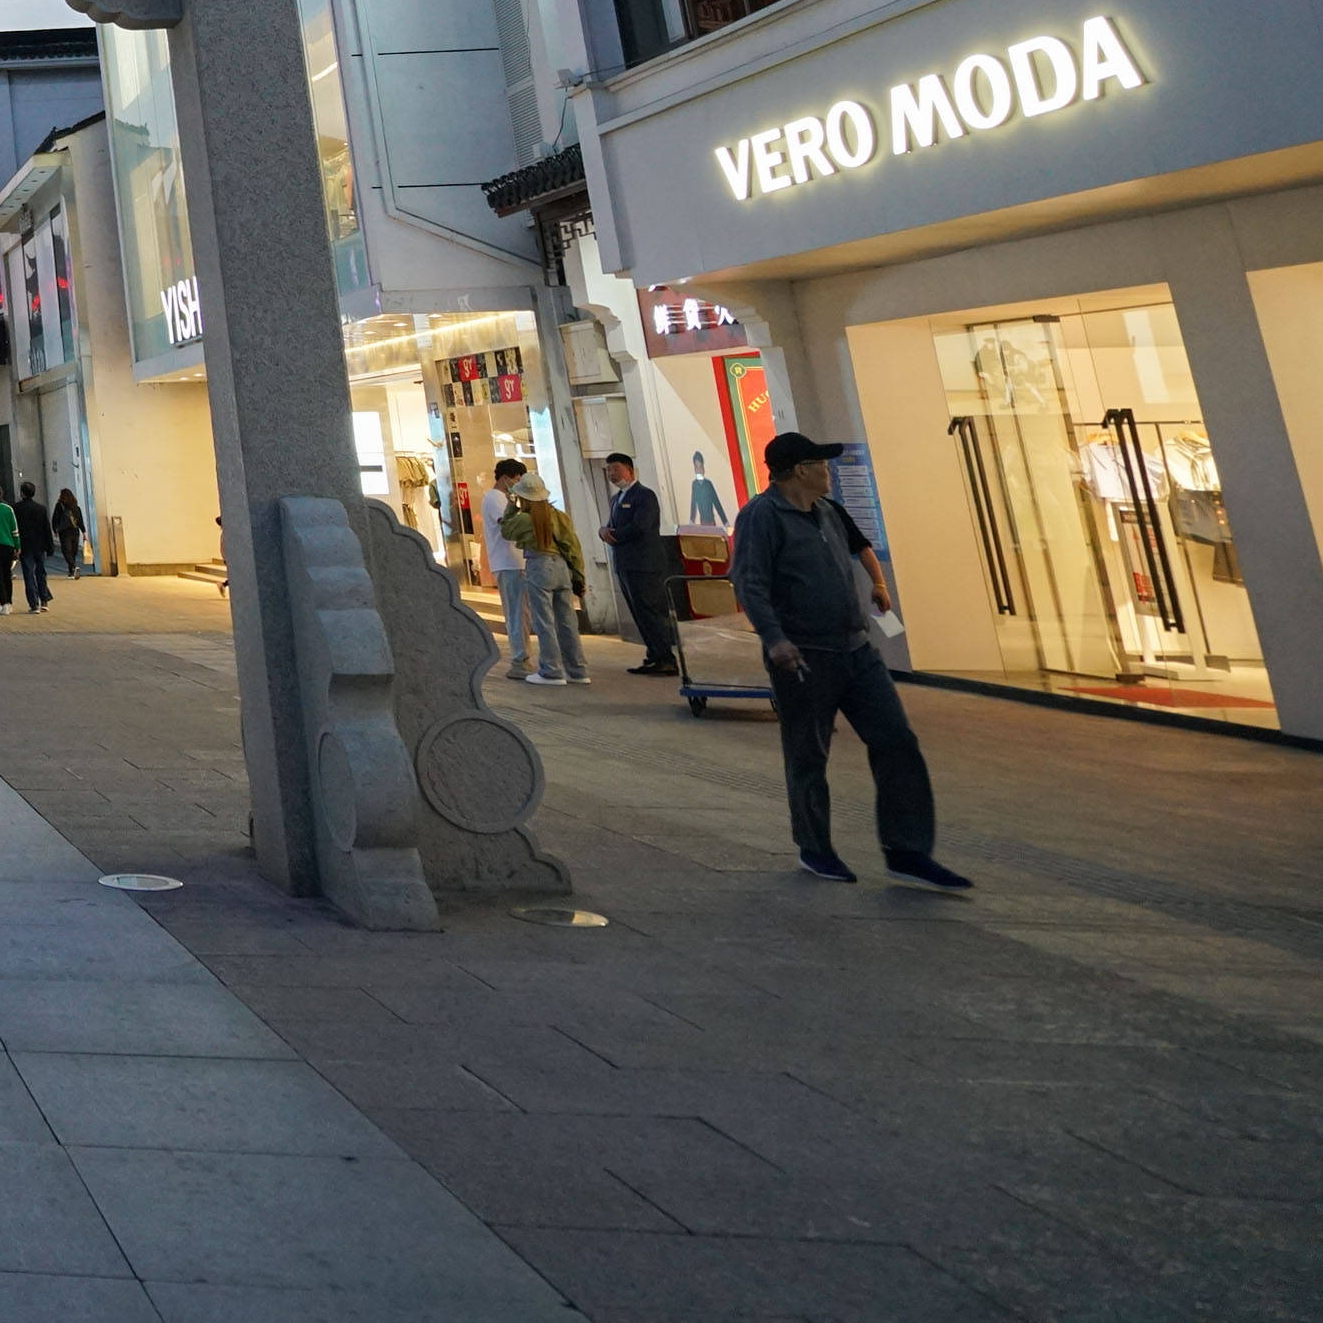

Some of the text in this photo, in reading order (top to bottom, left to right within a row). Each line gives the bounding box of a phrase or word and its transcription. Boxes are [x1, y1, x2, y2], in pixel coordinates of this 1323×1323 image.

[715, 15, 1146, 201] VERO MODA
[160, 275, 203, 345] YISH
